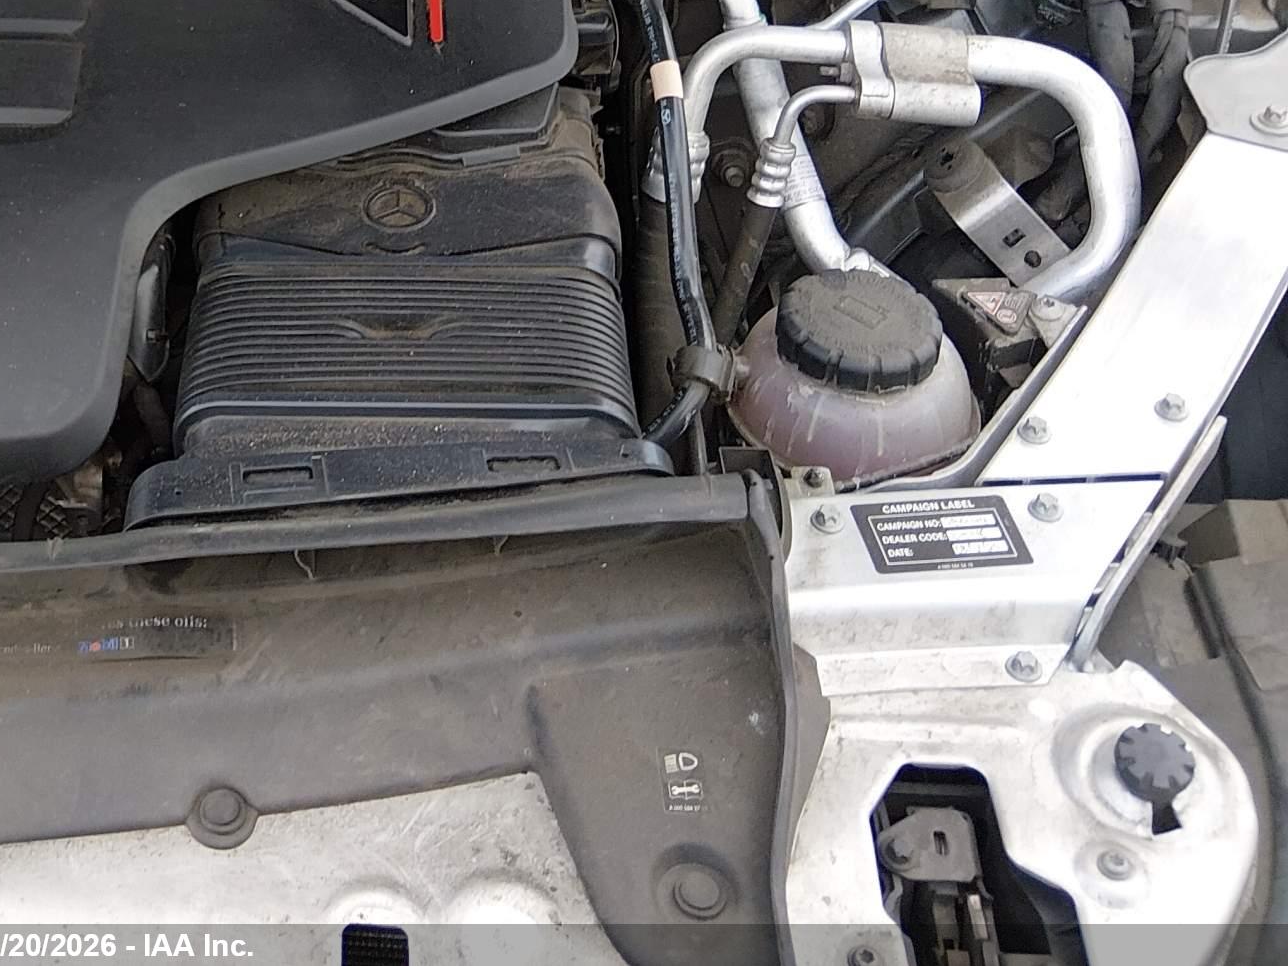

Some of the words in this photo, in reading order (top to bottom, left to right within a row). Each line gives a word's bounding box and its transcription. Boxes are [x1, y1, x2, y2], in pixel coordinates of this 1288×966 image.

[882, 501, 939, 514] CAMPAIGN
[941, 499, 975, 509] LABEL
[876, 520, 923, 531] CAMPAIGN
[881, 533, 917, 545] DEALER
[918, 532, 948, 542] CODE:
[887, 547, 913, 558] DATE:
